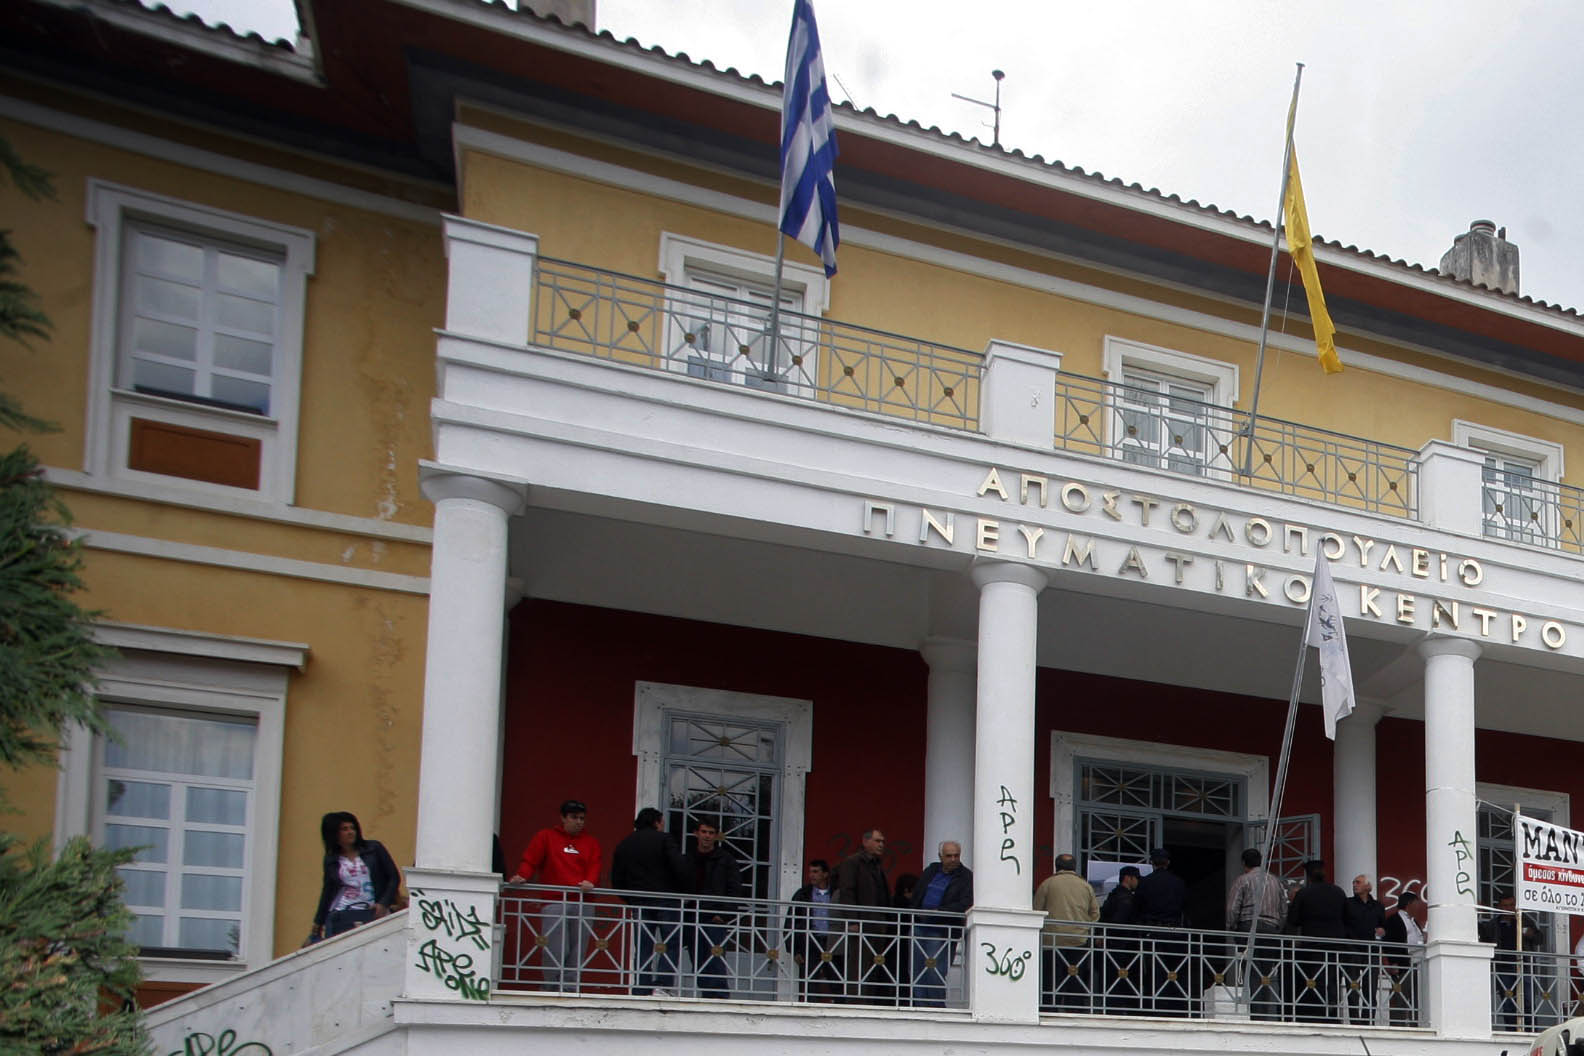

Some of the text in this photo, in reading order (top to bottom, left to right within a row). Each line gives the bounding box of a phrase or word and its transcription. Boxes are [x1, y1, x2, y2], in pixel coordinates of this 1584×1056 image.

[863, 499, 1312, 605] ΠΝΕΥΜΑΤΙΚΟ
[1360, 584, 1567, 650] ΚΕΝΤΡΟ
[976, 466, 1484, 588] ΑΠΟΣΤΟΛΟΠΟΥΛΕΙΟ
[1524, 889, 1538, 901] σε
[1541, 886, 1562, 904] όλο
[1565, 893, 1578, 906] το
